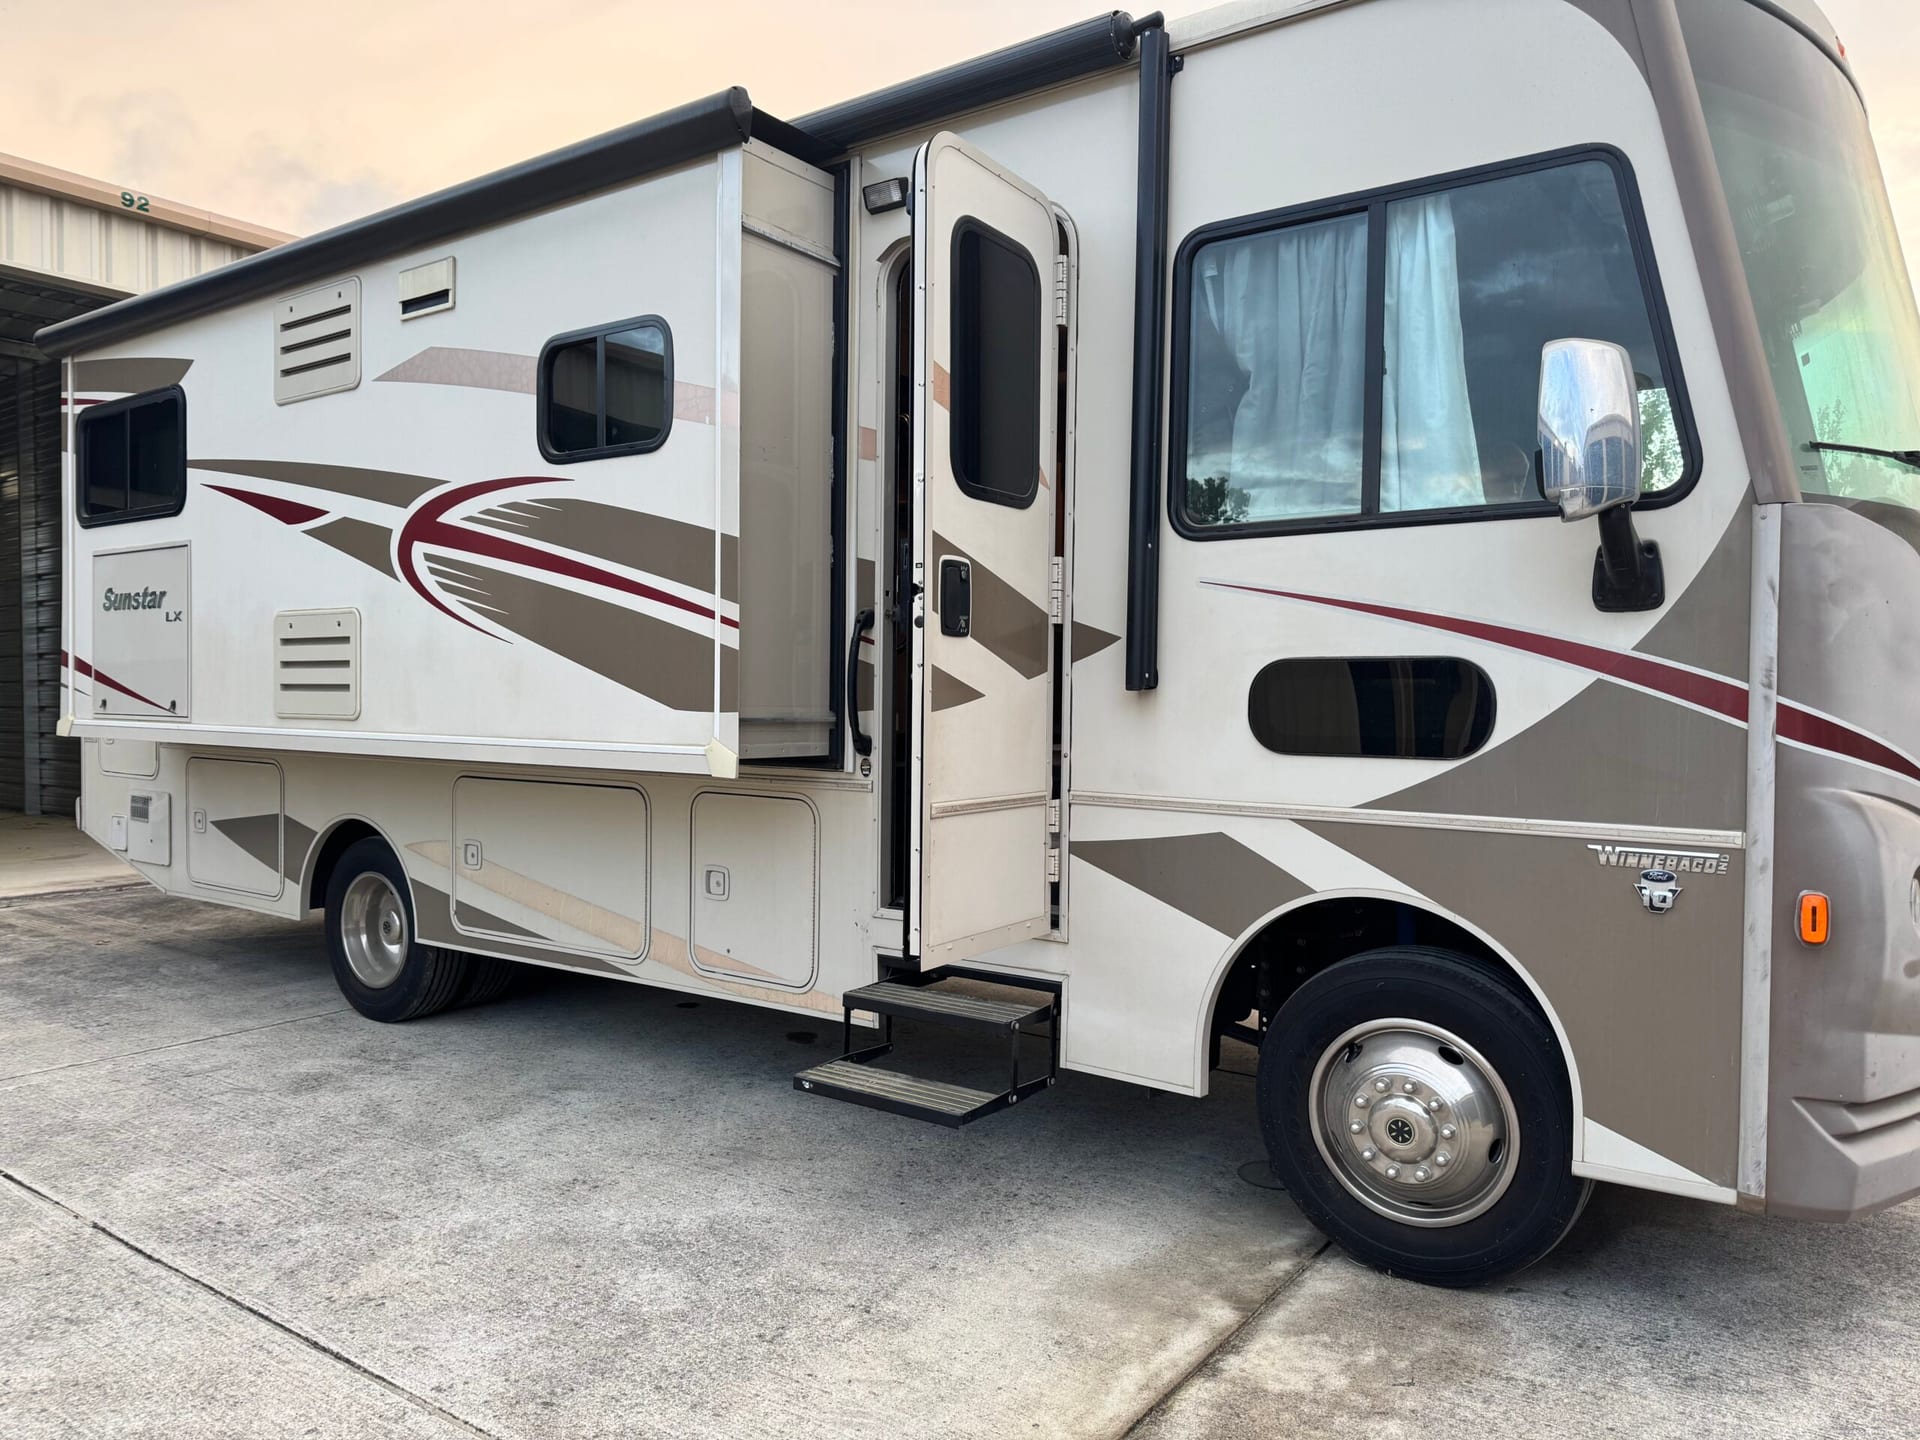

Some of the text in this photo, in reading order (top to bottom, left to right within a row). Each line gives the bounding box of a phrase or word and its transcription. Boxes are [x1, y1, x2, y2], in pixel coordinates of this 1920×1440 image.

[121, 191, 150, 213] 92
[103, 586, 167, 611] Sunstar
[165, 610, 183, 622] LX
[1587, 844, 1720, 874] WINNEBAGO
[1647, 870, 1669, 881] Ford
